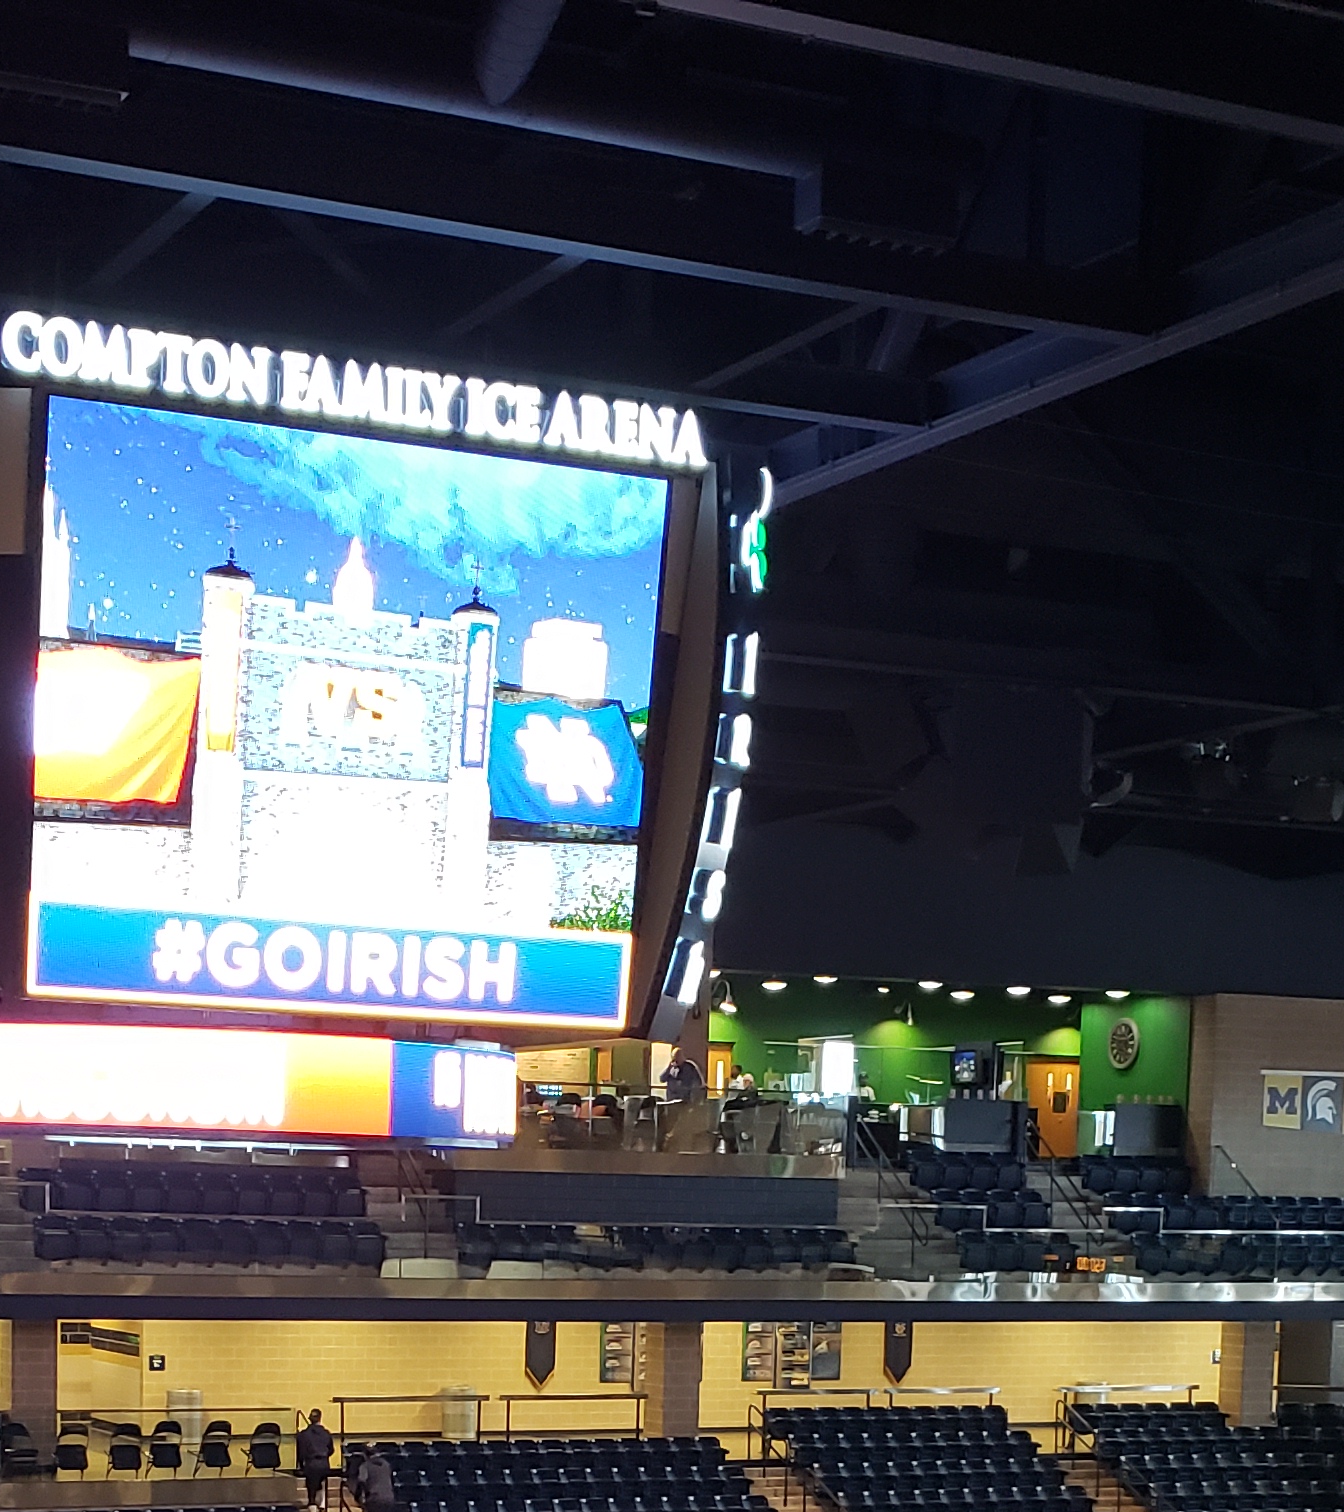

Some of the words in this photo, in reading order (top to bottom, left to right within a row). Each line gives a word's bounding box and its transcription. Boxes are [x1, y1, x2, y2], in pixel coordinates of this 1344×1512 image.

[1, 311, 268, 406] COMPTON
[280, 350, 461, 433] FAMILY
[465, 377, 542, 442] ICE
[538, 390, 707, 467] ARENA
[151, 917, 518, 1003] #GOIRISH
